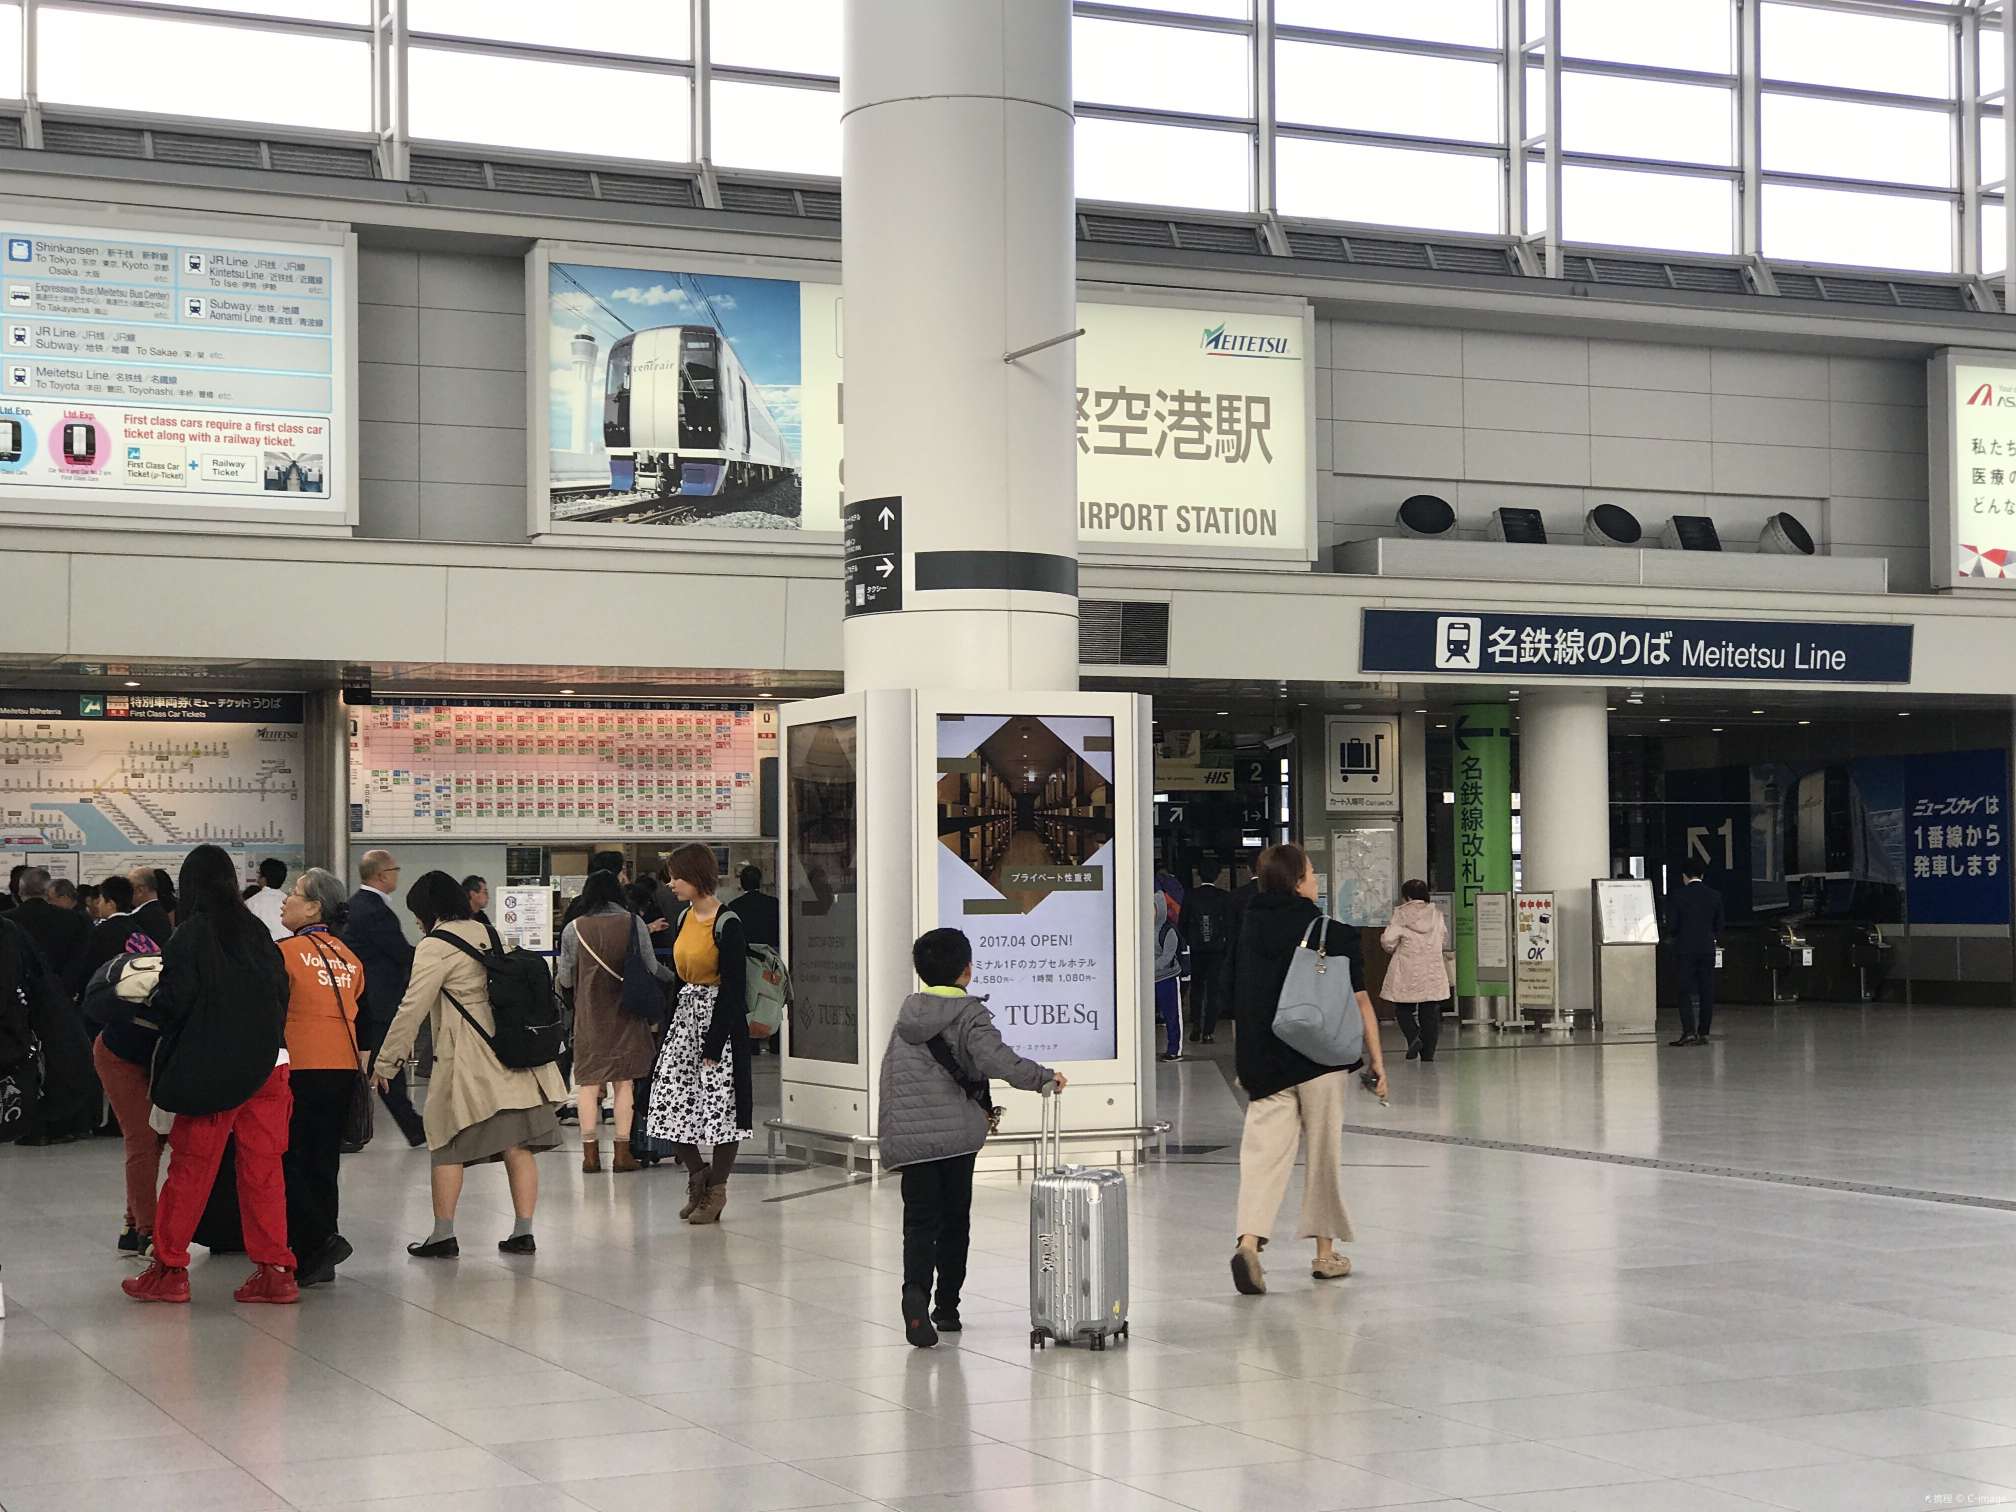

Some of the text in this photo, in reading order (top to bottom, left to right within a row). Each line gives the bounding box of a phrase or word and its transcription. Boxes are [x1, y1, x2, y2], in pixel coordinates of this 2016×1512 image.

[35, 241, 99, 256] Shinkansen
[36, 254, 47, 262] To
[50, 255, 77, 266] Tokyo
[122, 261, 149, 271] Kyoto
[210, 256, 224, 265] JR
[227, 257, 248, 267] Line
[49, 266, 78, 277] Osaka
[210, 268, 245, 279] Kintetsu
[246, 271, 264, 281] Line
[211, 278, 221, 287] To
[224, 279, 238, 288] Ise
[80, 284, 94, 294] Bus
[129, 289, 144, 298] Bus
[36, 303, 46, 311] To
[49, 304, 90, 315] Takayama
[210, 300, 251, 312] Subway
[210, 310, 242, 322] Aonami
[245, 313, 263, 322] Line
[36, 327, 51, 337] JR
[53, 328, 76, 338] Line
[1200, 322, 1288, 354] MEITETSU
[36, 339, 79, 352] Subway
[136, 346, 147, 356] To
[150, 348, 178, 358] Sakae
[36, 366, 83, 380] Meitetsu
[86, 369, 109, 380] Line
[633, 360, 676, 373] centrair
[36, 380, 46, 389] To
[50, 381, 80, 392] Toyota
[128, 386, 173, 398] Toyohashi
[1997, 397, 2016, 408] AS
[124, 414, 323, 435] First class cars require a first class car
[1076, 386, 1273, 465] 空港駅
[124, 429, 295, 447] ticket along with a railway ticket.
[1972, 438, 2016, 456] 私たち
[128, 461, 180, 471] First Class Car
[213, 459, 245, 469] Railway
[128, 470, 150, 478] Ticket
[213, 469, 239, 477] Ticket
[1973, 497, 2016, 515] どんな
[1080, 501, 1277, 536] IRPORT STATION
[867, 586, 887, 594] タクシー
[1487, 627, 1673, 666] 名鉄線のりば
[1683, 638, 1846, 671] Meitetsu Line
[130, 710, 146, 718] First
[182, 711, 206, 719] Tickets
[1204, 772, 1231, 785] HIS
[1250, 763, 1262, 781] 2
[1243, 810, 1248, 822] 1
[1460, 755, 1484, 907] 名鉄線改札口
[1914, 824, 2001, 850] 1番線から
[1718, 818, 1734, 870] 1
[1913, 854, 2001, 879] 発車します
[1011, 873, 1092, 883] プライベート性重視
[980, 934, 1073, 948] 2017.04 OPEN!
[1528, 947, 1546, 960] OK
[972, 958, 1096, 970] ミナル1Fのカプセルホテル
[317, 970, 352, 989] Staff
[1032, 975, 1053, 984] 1時間
[1005, 1003, 1100, 1030] TUBE Sq
